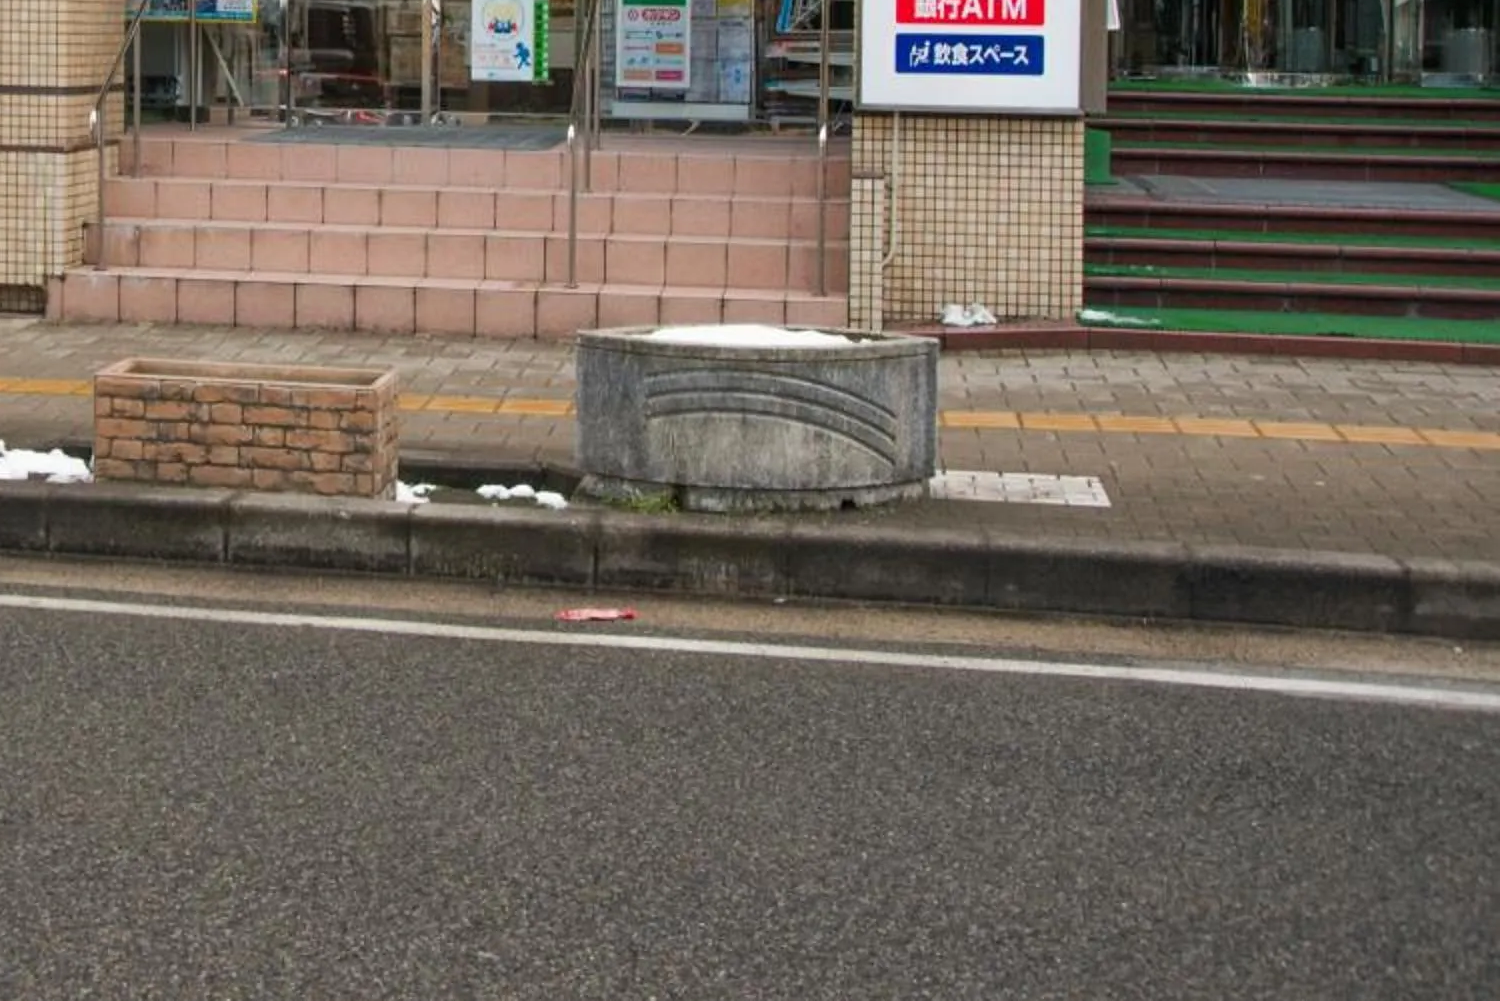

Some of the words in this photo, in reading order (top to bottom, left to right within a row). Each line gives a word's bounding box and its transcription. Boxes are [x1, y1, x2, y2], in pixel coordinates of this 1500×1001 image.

[933, 42, 1030, 66] 飲食スペース
